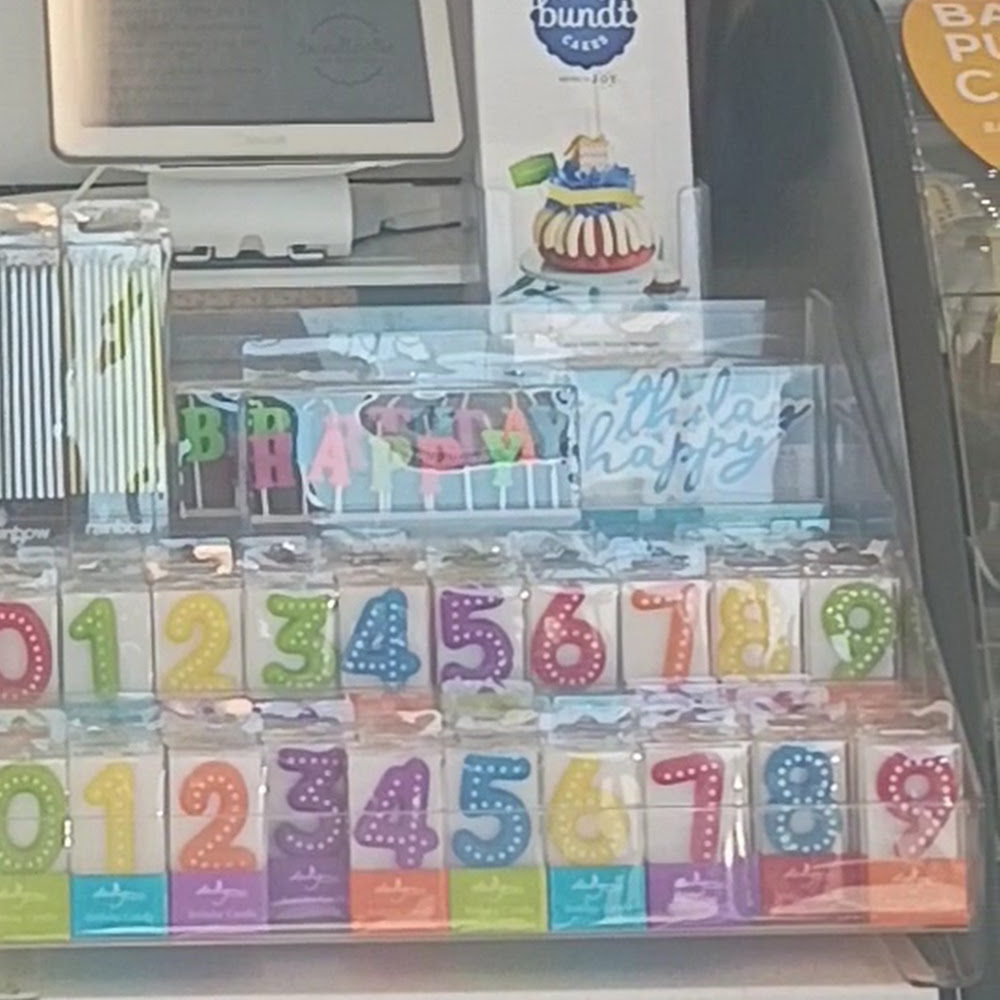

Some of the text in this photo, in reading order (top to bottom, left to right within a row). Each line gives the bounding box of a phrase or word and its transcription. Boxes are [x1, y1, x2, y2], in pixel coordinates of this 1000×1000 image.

[561, 34, 609, 51] CAKES
[68, 596, 120, 699] 1
[163, 593, 235, 692] 2
[261, 593, 338, 690] 3
[342, 588, 422, 689] 4
[440, 588, 514, 686] 5
[530, 586, 607, 689] 6
[631, 584, 697, 688] 7
[821, 582, 897, 681] 9
[83, 762, 135, 873] 1
[178, 761, 257, 871] 2
[274, 747, 349, 857] 3
[354, 758, 440, 870] 4
[452, 753, 532, 867] 5
[547, 757, 631, 866] 6
[651, 752, 724, 866] 7
[763, 745, 842, 857] 8
[875, 751, 956, 858] 9
